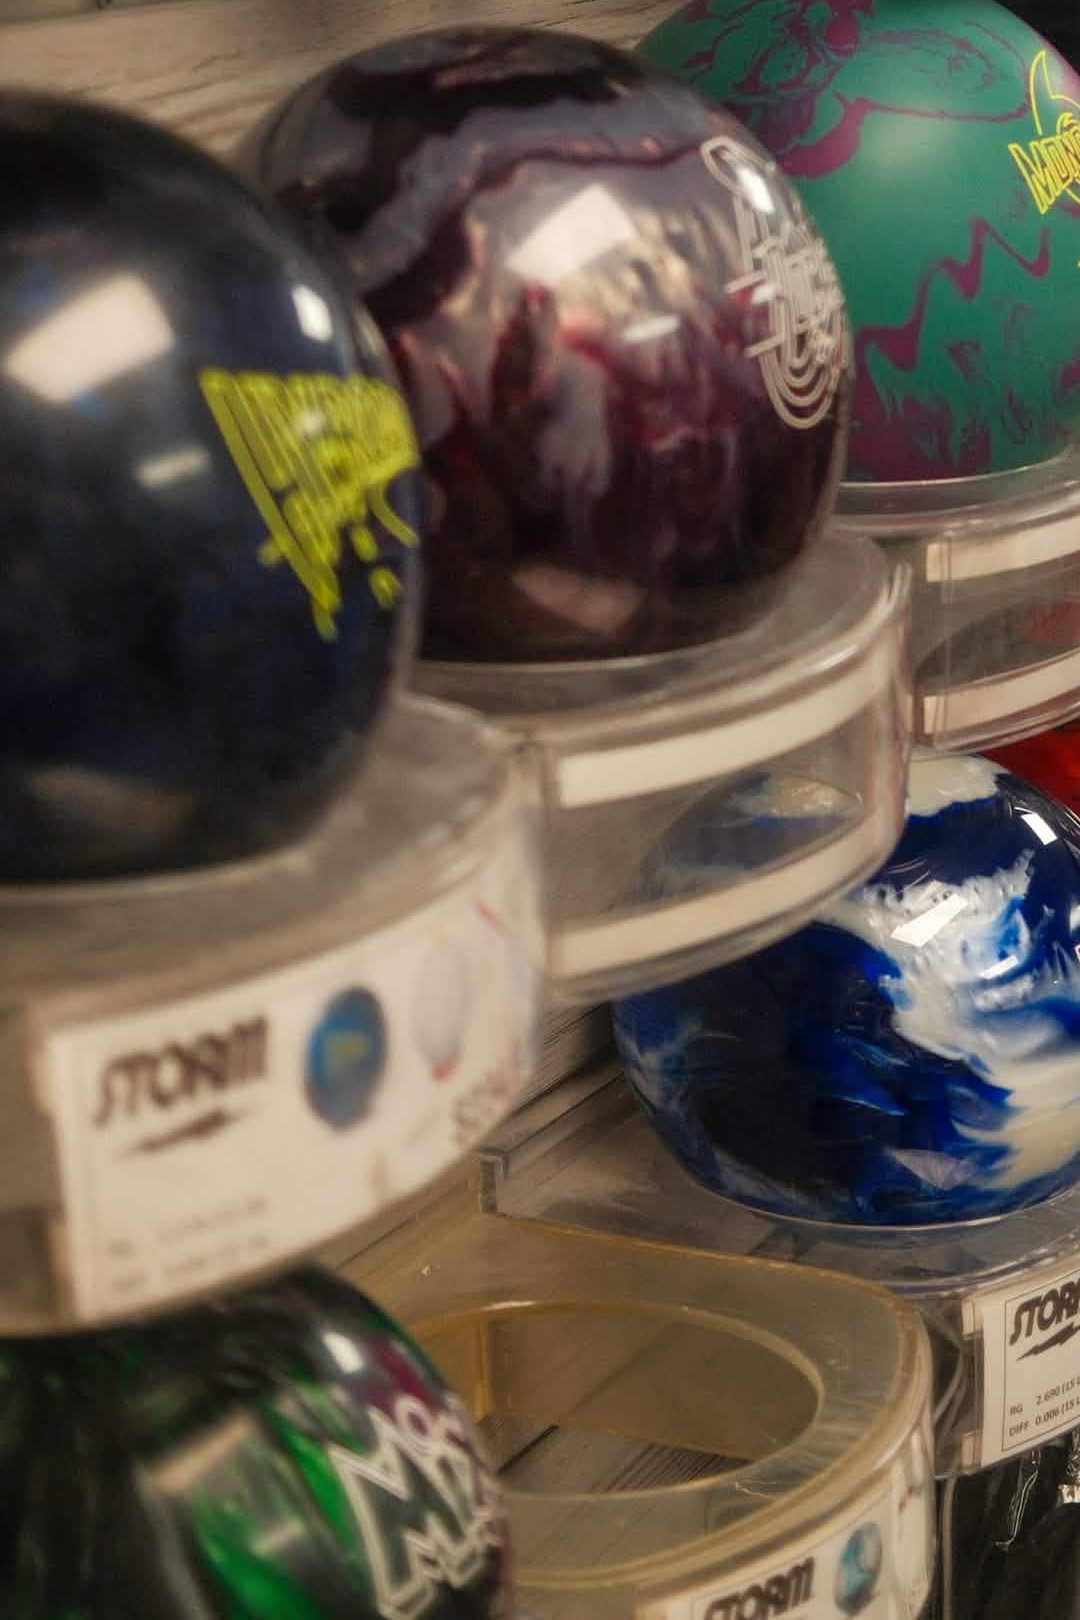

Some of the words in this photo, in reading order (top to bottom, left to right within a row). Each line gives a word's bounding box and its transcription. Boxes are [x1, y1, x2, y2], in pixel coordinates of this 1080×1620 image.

[1009, 1403, 1024, 1417] RG
[1035, 1385, 1062, 1405] 2.690
[1008, 1419, 1030, 1437] DIFF
[1034, 1406, 1061, 1426] 0.006
